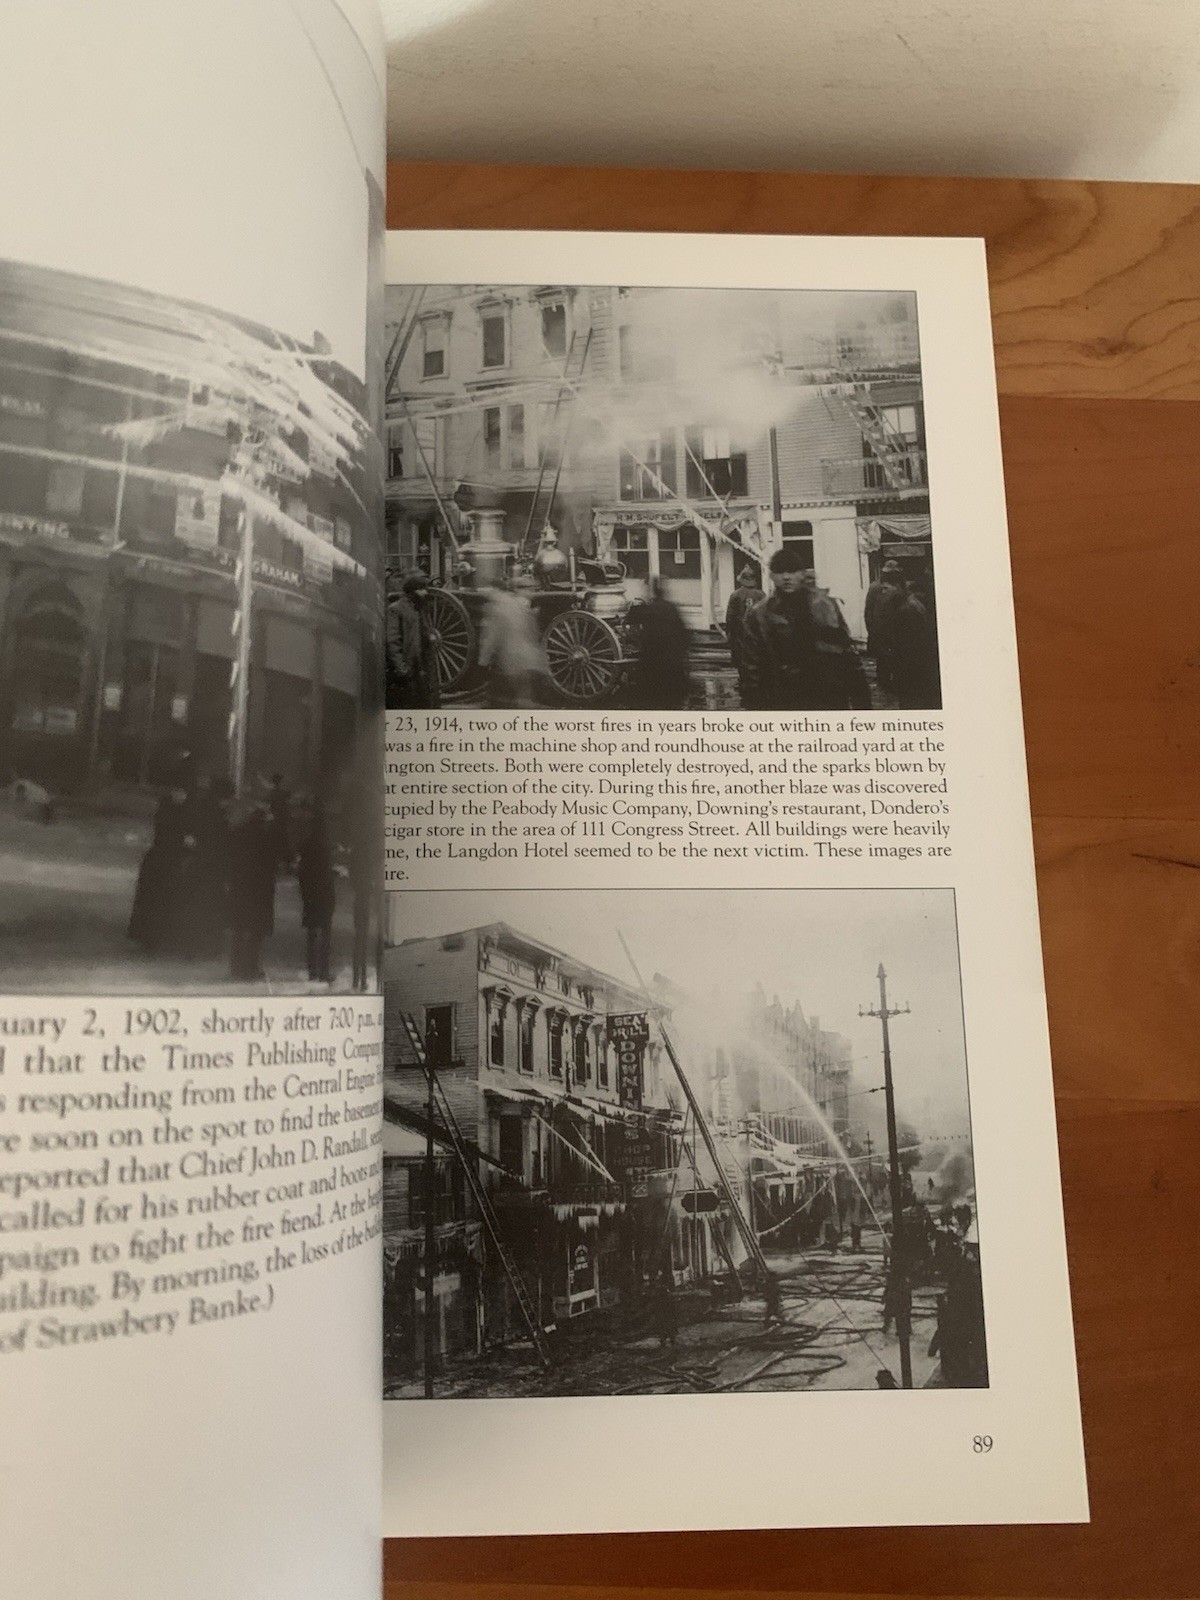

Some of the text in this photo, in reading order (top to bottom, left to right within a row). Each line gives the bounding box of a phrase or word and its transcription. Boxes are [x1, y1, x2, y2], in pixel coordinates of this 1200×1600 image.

[395, 716, 417, 735] 23,
[426, 716, 462, 735] 1914,
[469, 719, 497, 732] two
[503, 716, 519, 732] of
[524, 716, 548, 732] the
[555, 719, 595, 732] worst
[601, 716, 631, 732] fires
[638, 718, 652, 732] in
[659, 721, 696, 736] years
[702, 716, 743, 732] broke
[750, 718, 773, 732] out
[780, 716, 830, 732] within
[837, 721, 844, 731] a
[850, 716, 875, 731] few
[882, 717, 943, 731] minutes
[384, 737, 944, 756] was a fire in the machine shop and roundhouse at the railroad yard at the
[441, 758, 498, 774] Streets.
[505, 758, 543, 774] Both
[548, 763, 583, 774] were
[589, 758, 671, 777] completely
[677, 758, 753, 777] destroyed,
[759, 758, 787, 773] and
[793, 758, 817, 773] the
[823, 758, 870, 777] sparks
[875, 758, 923, 773] blown
[928, 758, 945, 777] by
[401, 780, 447, 795] entire
[452, 780, 508, 795] section
[513, 779, 529, 794] of
[532, 779, 557, 794] the
[562, 780, 593, 798] city.
[599, 779, 654, 798] During
[659, 779, 687, 794] this
[691, 778, 720, 797] fire,
[725, 778, 785, 794] another
[790, 778, 827, 794] blaze
[833, 783, 860, 794] was
[865, 778, 947, 794] discovered
[384, 800, 433, 820] cupied
[439, 800, 456, 819] by
[462, 800, 487, 816] the
[493, 800, 557, 819] Peabody
[562, 800, 608, 816] Music
[613, 800, 691, 819] Company,
[783, 802, 865, 818] restaurant,
[384, 820, 949, 840] cigar store in the area of 111 Congress Street. All buildings were heavily
[416, 842, 441, 858] the
[448, 842, 517, 862] Langdon
[525, 842, 568, 858] Hotel
[574, 842, 631, 858] seemed
[638, 844, 653, 858] to
[659, 842, 676, 857] be
[683, 842, 707, 857] the
[714, 844, 748, 857] next
[754, 843, 808, 857] victim.
[814, 841, 862, 857] These
[869, 843, 922, 861] images
[928, 846, 951, 857] are
[82, 1008, 105, 1037] 2,
[125, 1008, 188, 1037] 1902,
[202, 1007, 274, 1037] shortly
[283, 1007, 321, 1031] after
[329, 1006, 354, 1029] 7:00
[24, 1045, 84, 1075] that
[102, 1044, 147, 1073] the
[162, 1043, 234, 1070] Times
[247, 1040, 337, 1067] Publishing
[18, 1081, 173, 1119] responding
[181, 1079, 235, 1107] from
[244, 1076, 277, 1101] the
[283, 1069, 342, 1099] Central
[346, 1068, 375, 1093] Engine
[30, 1130, 99, 1151] soon
[108, 1128, 143, 1146] on
[152, 1117, 194, 1145] the
[201, 1118, 247, 1146] spot
[255, 1117, 275, 1136] to
[280, 1106, 313, 1133] find
[318, 1103, 341, 1128] the
[118, 1155, 171, 1185] that
[179, 1146, 247, 1179] Chief
[249, 1143, 295, 1176] John
[301, 1138, 318, 1164] D.
[95, 1195, 132, 1225] for
[141, 1193, 178, 1220] his
[187, 1183, 260, 1216] rubber
[266, 1181, 303, 1203] coat
[309, 1167, 337, 1195] and
[341, 1165, 367, 1187] boots
[91, 1243, 120, 1265] to
[129, 1228, 187, 1264] fight
[196, 1222, 235, 1249] the
[242, 1215, 275, 1243] fire
[280, 1203, 325, 1236] fiend.
[329, 1200, 347, 1223] At
[350, 1193, 365, 1217] the
[112, 1270, 146, 1302] By
[152, 1259, 259, 1294] morning,
[266, 1246, 297, 1273] the
[302, 1240, 329, 1265] loss
[331, 1228, 346, 1256] of
[347, 1226, 364, 1251] the
[36, 1308, 180, 1349] Strawbery
[189, 1283, 274, 1325] Banke.)
[973, 1435, 993, 1453] 89
